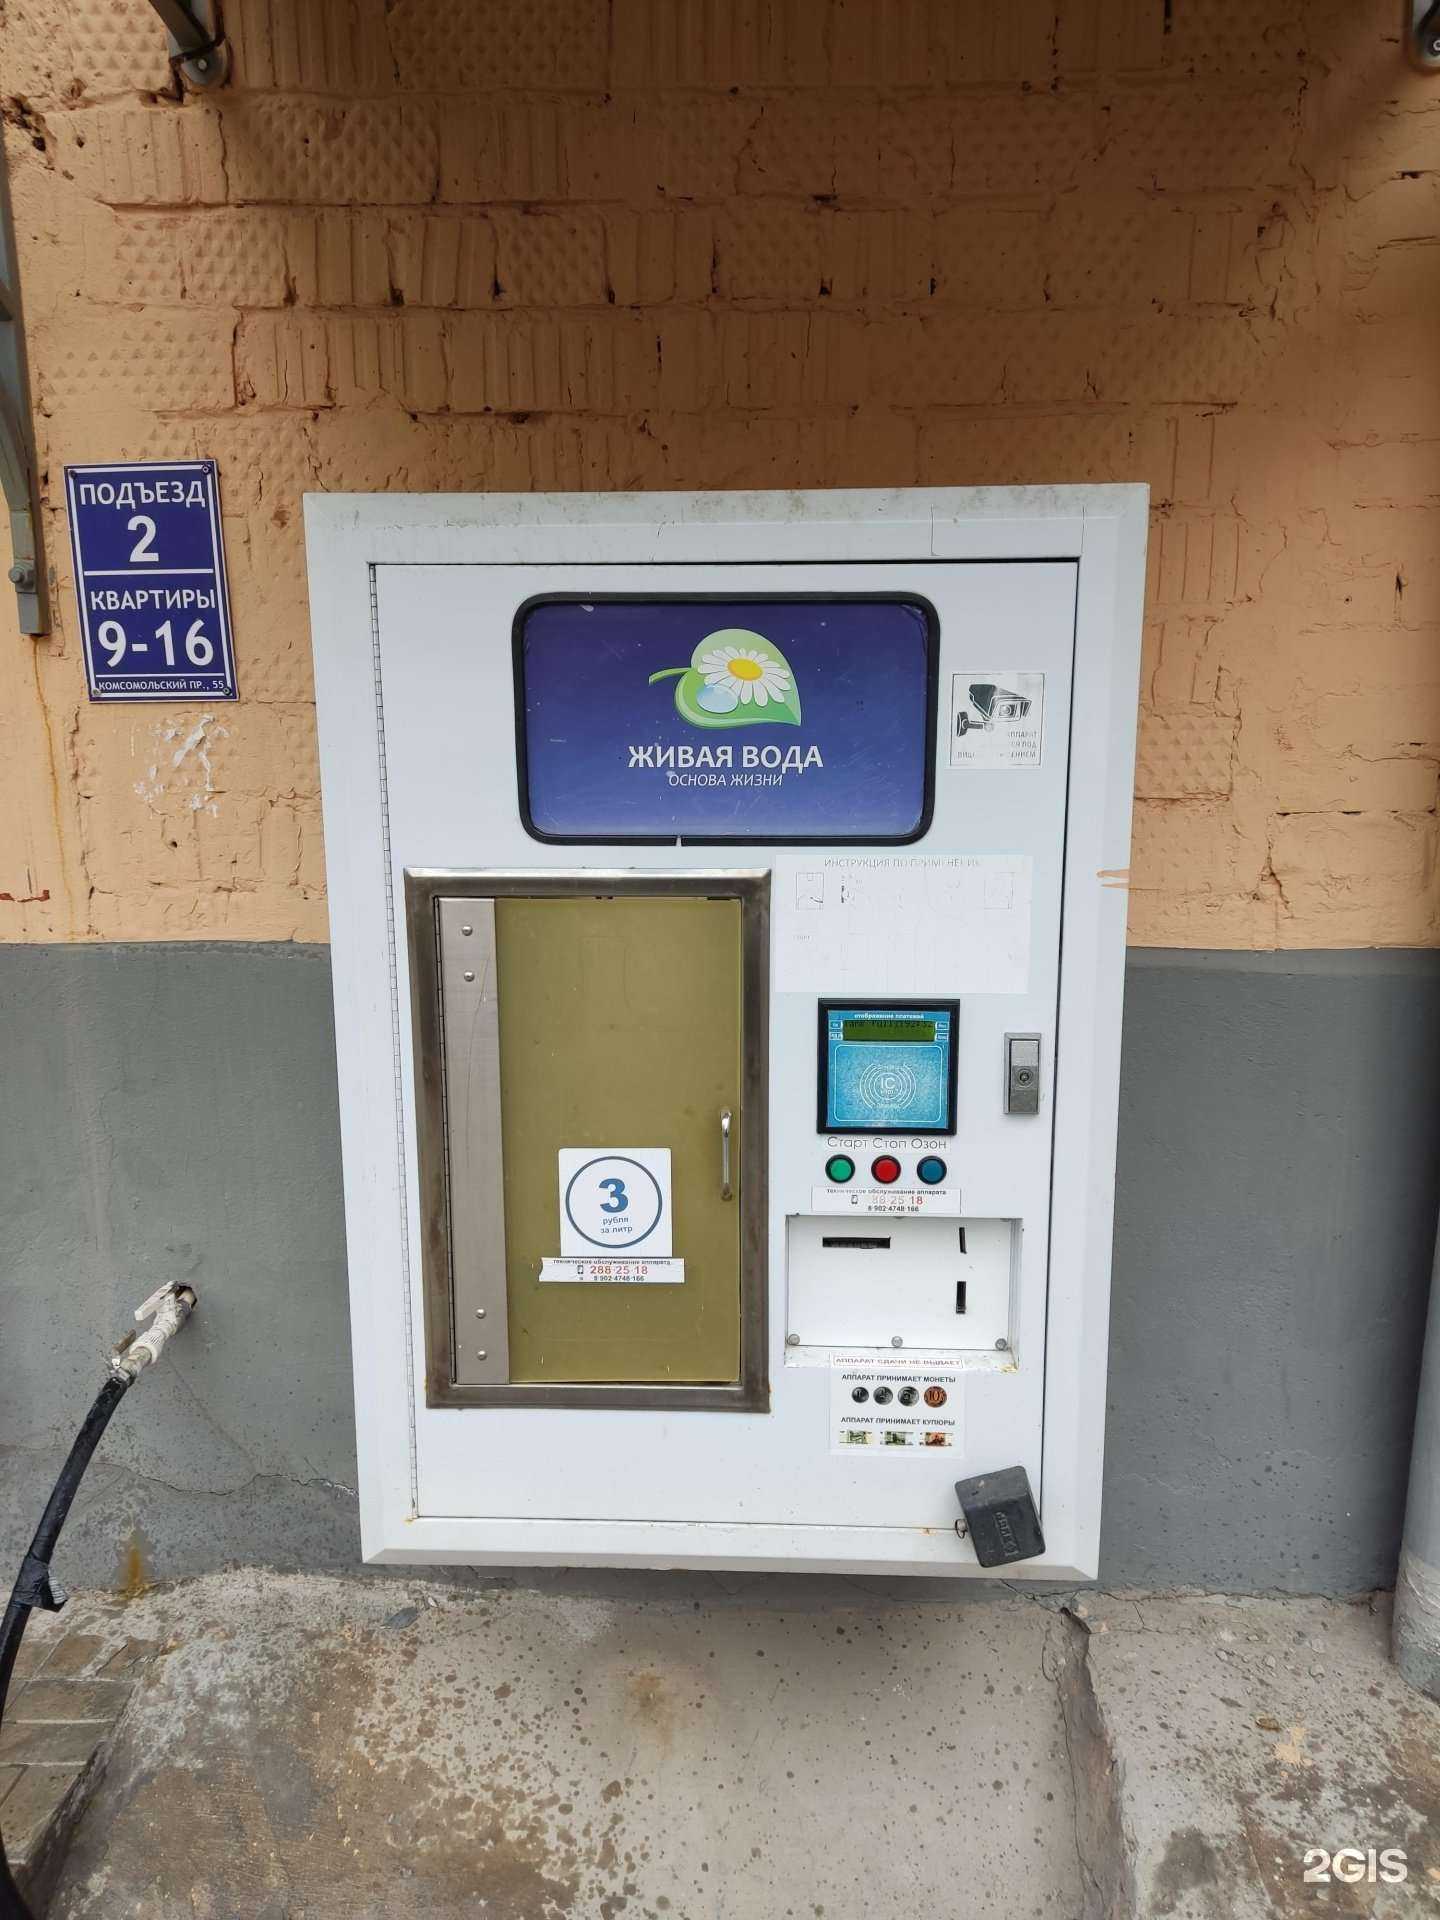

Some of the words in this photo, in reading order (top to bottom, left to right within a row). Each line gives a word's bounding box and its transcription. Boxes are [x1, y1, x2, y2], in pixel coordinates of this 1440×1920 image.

[79, 481, 206, 510] ПОДЪЕЗД
[127, 515, 159, 562] 2
[90, 588, 216, 610] КВАРТИРЫ
[97, 618, 214, 668] 9-16
[98, 679, 187, 691] КОМСОМОЛЬСКИЙ
[212, 680, 224, 690] 55
[628, 745, 733, 768] ЖИВАЯ
[742, 745, 824, 774] ВОДА
[668, 774, 727, 787] ОСНОВА
[730, 774, 783, 787] ЖИЗНИ
[824, 858, 890, 868] ИНСТРУКЦИЯ
[827, 1136, 868, 1149] Старт
[872, 1137, 907, 1149] Стоп
[911, 1138, 947, 1149] Озон
[598, 1178, 629, 1213] 3
[602, 1216, 629, 1226] рубля
[875, 1417, 921, 1425] ПРИНИМАЕТ
[922, 1418, 956, 1426] КУПЮРЫ
